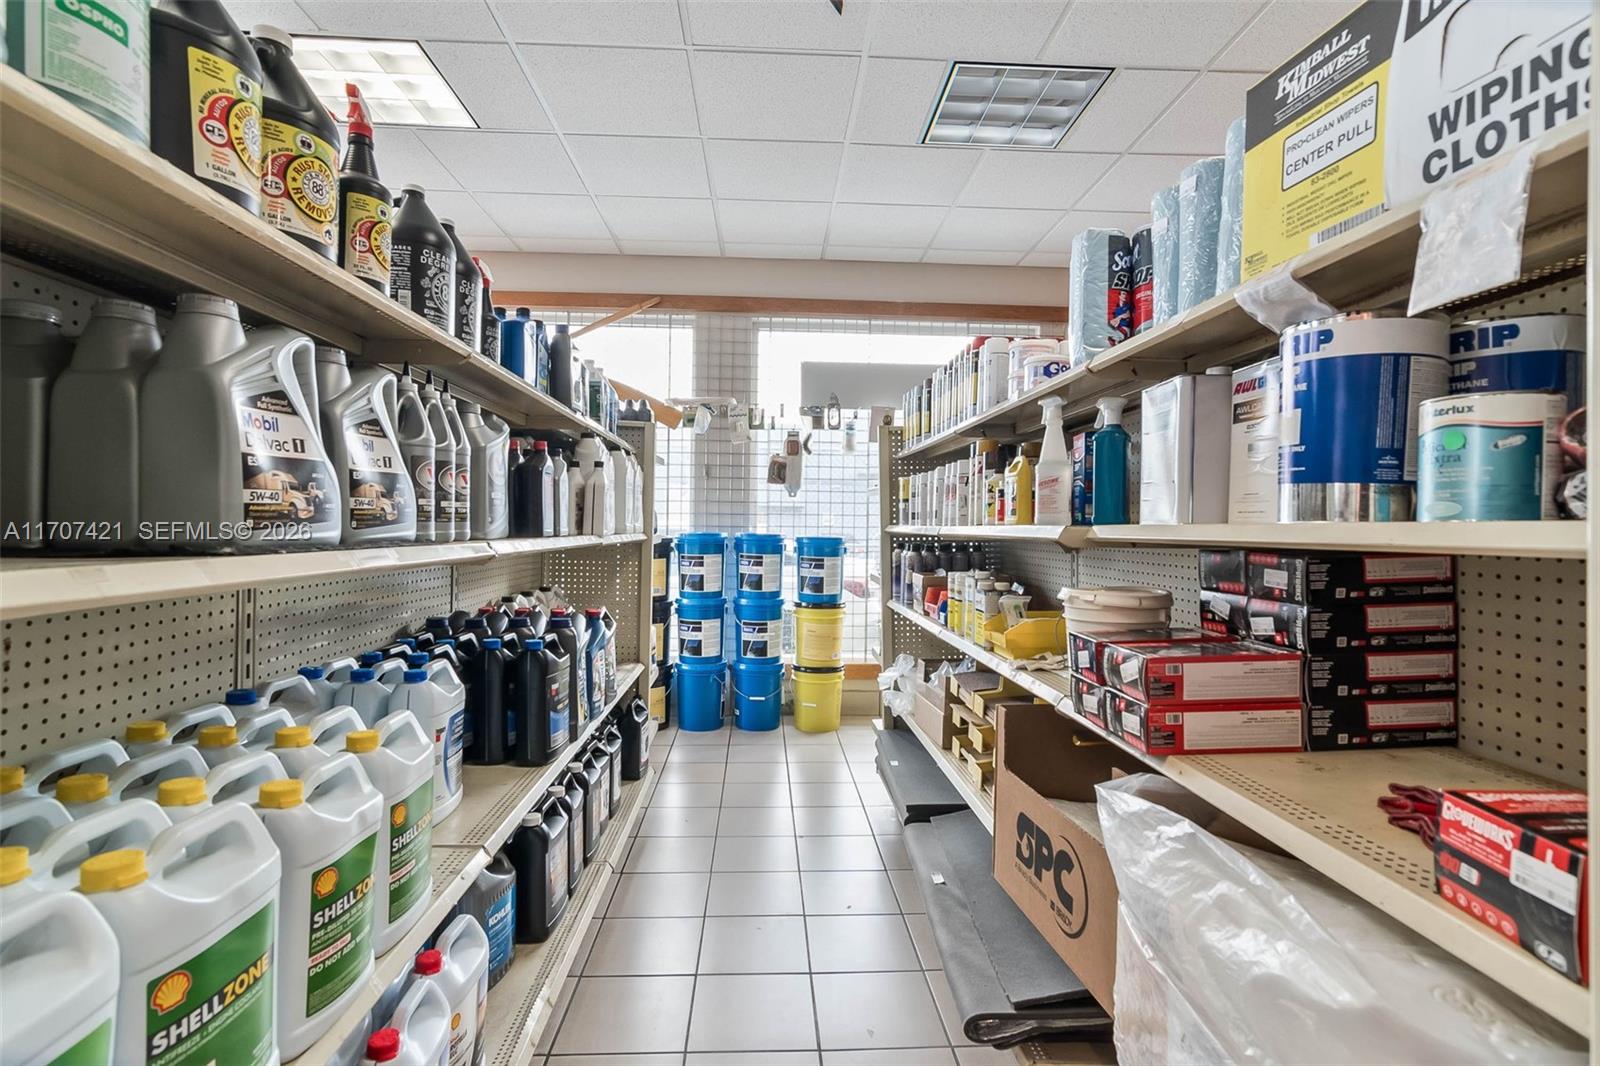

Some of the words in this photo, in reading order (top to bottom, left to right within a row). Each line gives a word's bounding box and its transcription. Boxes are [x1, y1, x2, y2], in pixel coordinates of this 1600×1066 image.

[1275, 29, 1352, 100] KIMBALL
[1287, 34, 1371, 104] MIDWEST
[1428, 27, 1590, 143] WIPING
[1285, 140, 1334, 176] CENTER
[1337, 119, 1373, 147] PULL
[1286, 120, 1335, 155] PRO-CLEAN
[1336, 95, 1374, 124] WIPERS
[293, 159, 316, 177] RUST
[1450, 324, 1520, 355] RIP
[243, 412, 279, 433] Mobil
[249, 491, 280, 502] 5W-40
[353, 499, 375, 508] 5W-40
[1016, 811, 1075, 916] SPC
[309, 964, 324, 977] DO
[324, 950, 342, 968] NOT
[151, 951, 271, 1056] SHELLZONE
